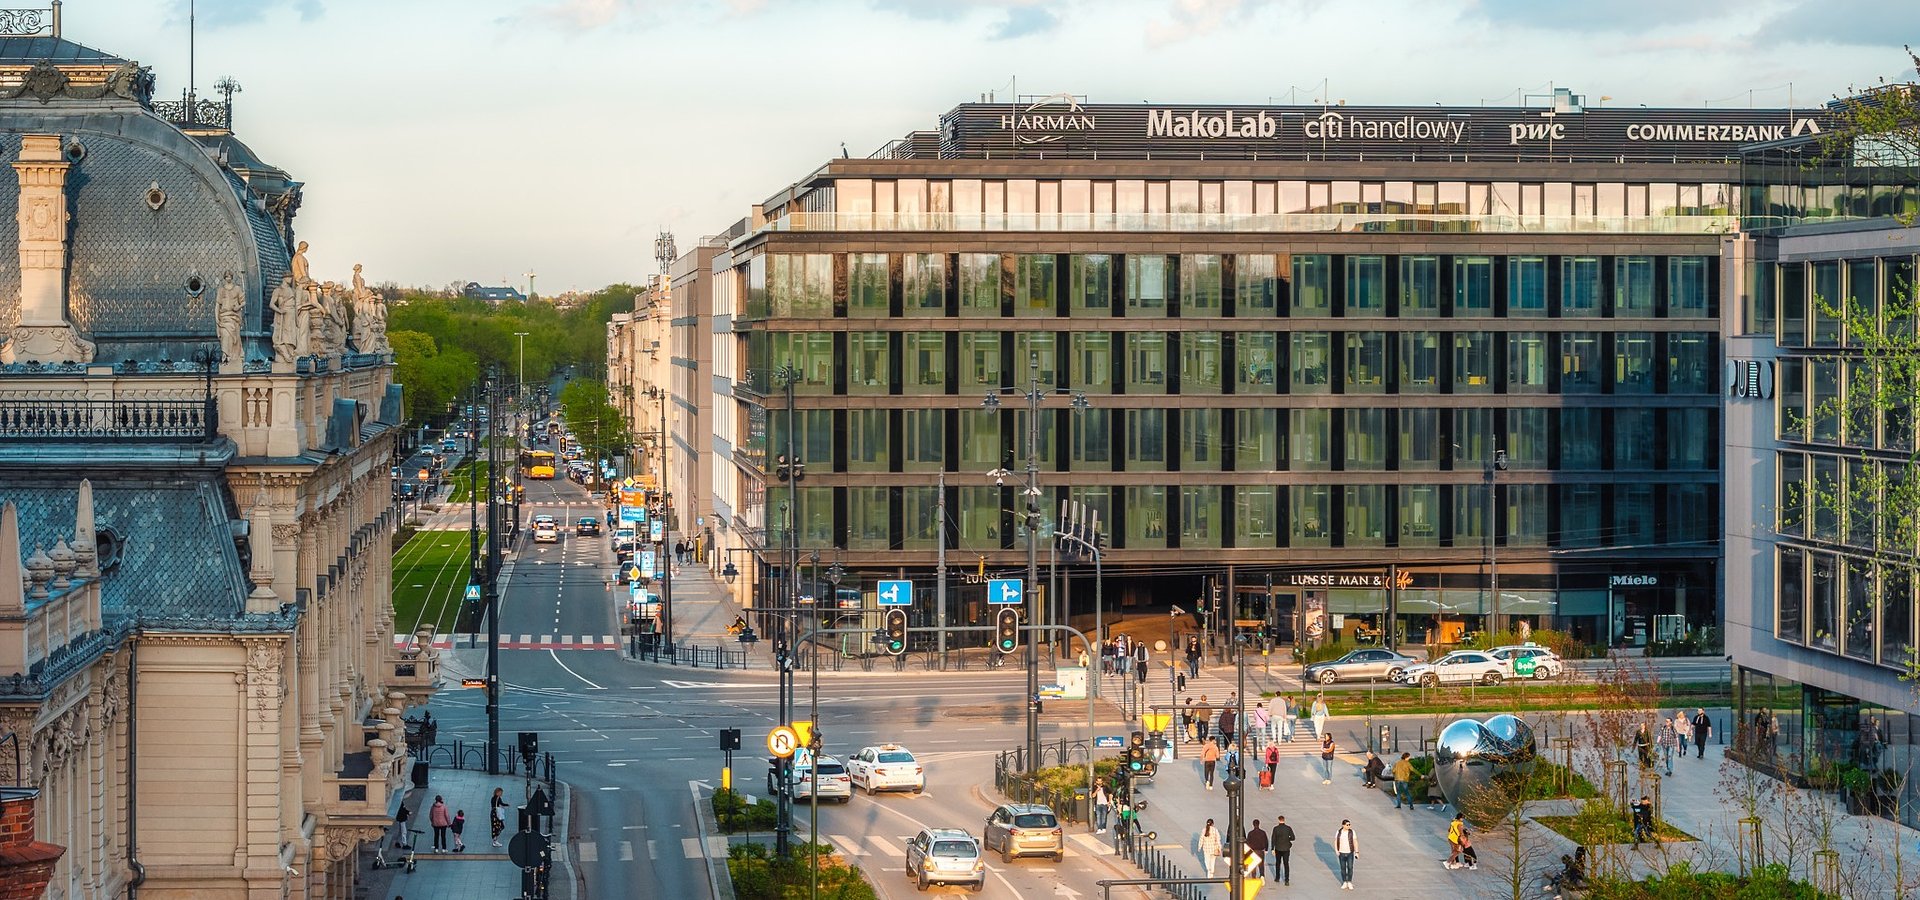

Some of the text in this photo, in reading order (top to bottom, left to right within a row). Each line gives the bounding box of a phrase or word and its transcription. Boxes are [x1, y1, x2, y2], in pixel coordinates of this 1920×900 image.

[1001, 115, 1095, 130] HARMAN
[1147, 109, 1276, 138] MakoLab
[1305, 112, 1465, 144] citi handlowy
[1509, 123, 1565, 145] pwc
[1626, 124, 1785, 141] COMMERZBANK
[1727, 359, 1773, 399] PURO
[1339, 576, 1369, 586] MAN
[1373, 576, 1382, 586] &
[1612, 575, 1657, 585] Miele
